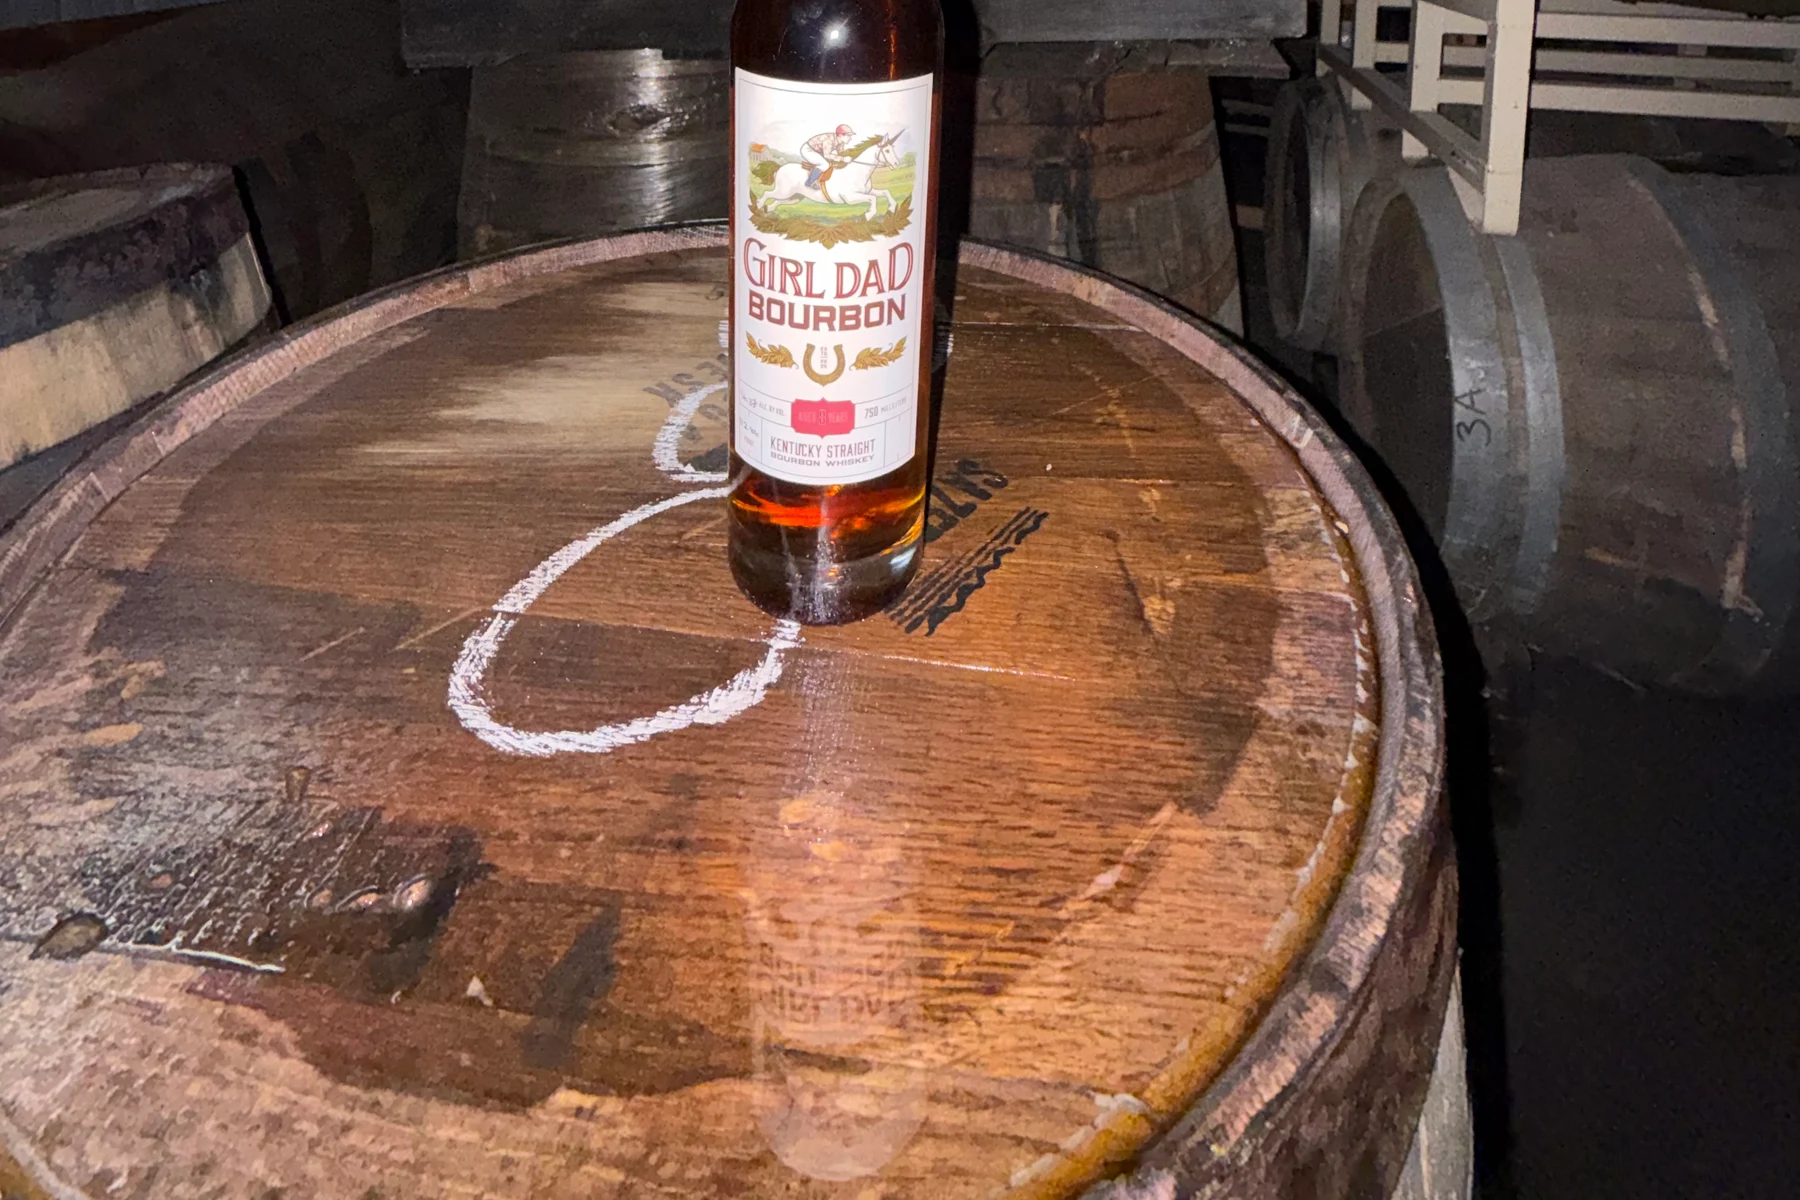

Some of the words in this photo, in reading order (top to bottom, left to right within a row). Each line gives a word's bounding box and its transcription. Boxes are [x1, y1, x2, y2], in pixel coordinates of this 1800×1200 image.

[743, 237, 826, 299] GIRL
[833, 242, 914, 299] DAD
[748, 289, 906, 332] BOURBON
[828, 411, 849, 424] YEARS
[864, 406, 879, 420] 750
[770, 436, 822, 459] KENTUCKY
[826, 438, 876, 459] STRAIGHT
[770, 451, 821, 467] BOURBON
[825, 453, 875, 467] WHISKEY
